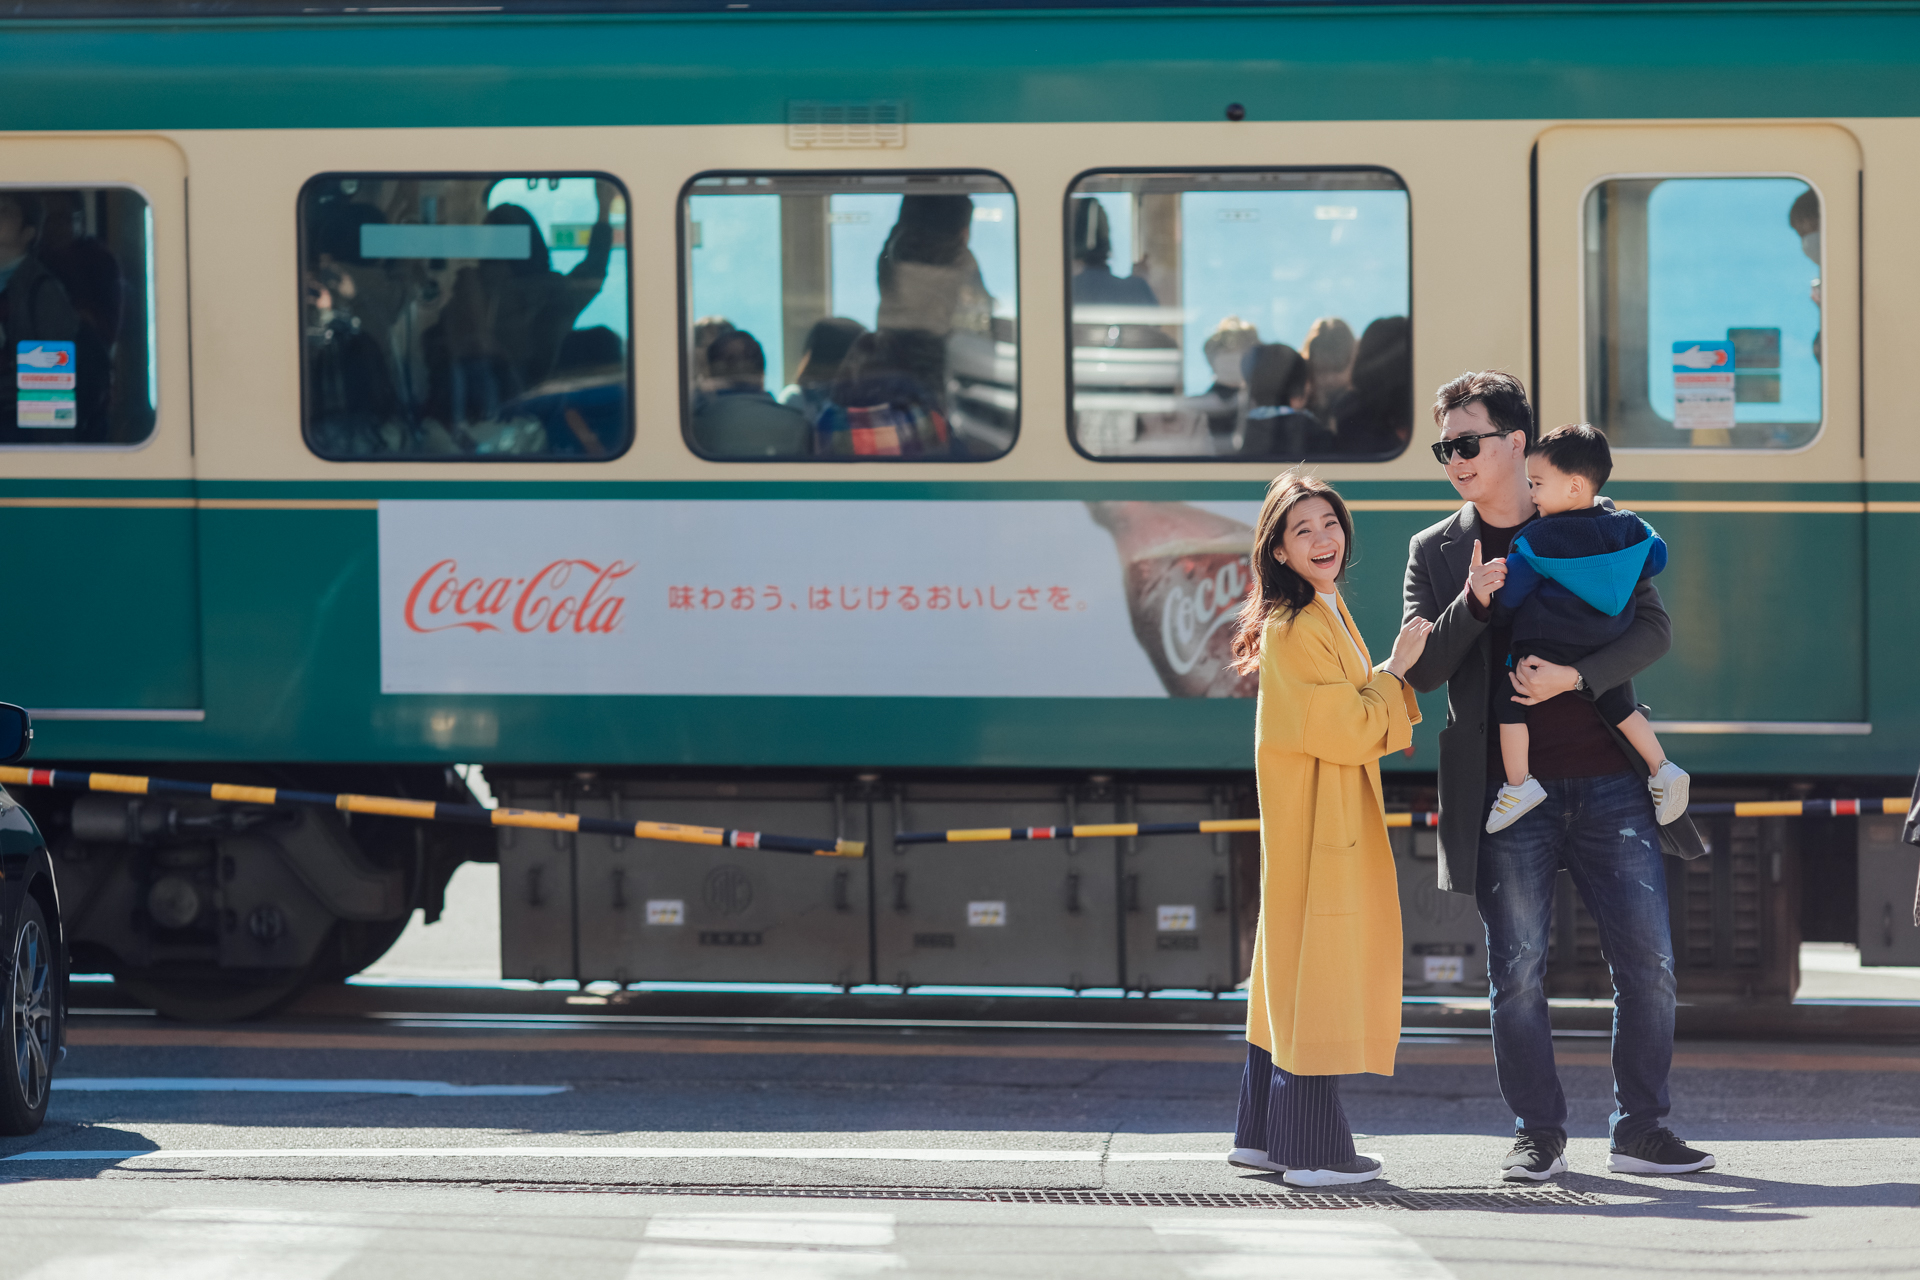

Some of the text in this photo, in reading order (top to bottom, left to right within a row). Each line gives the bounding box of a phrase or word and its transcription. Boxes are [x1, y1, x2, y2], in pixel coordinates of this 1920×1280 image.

[668, 585, 1087, 611] 味わおう、はじけるおいしさを。
